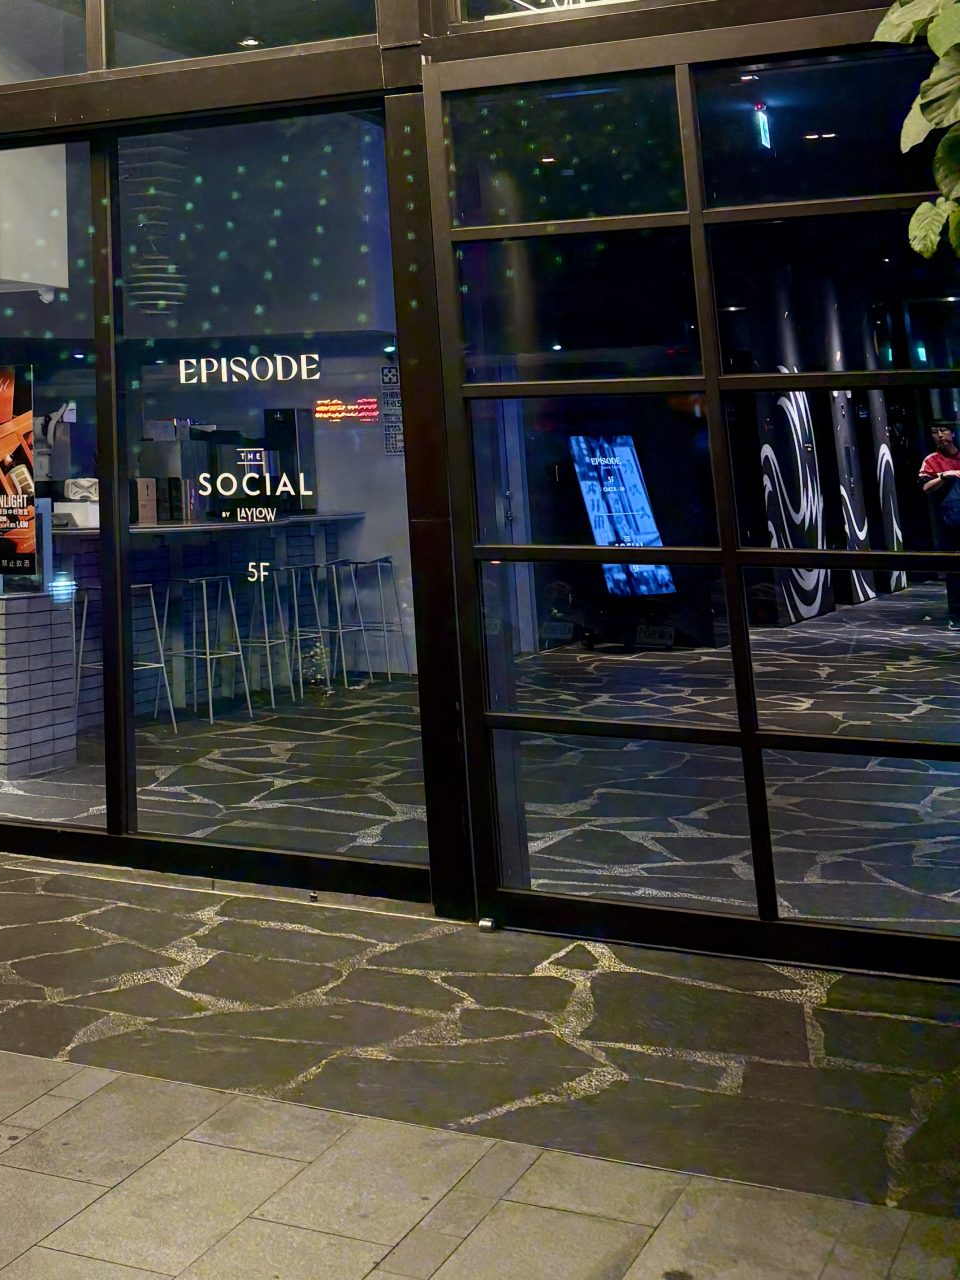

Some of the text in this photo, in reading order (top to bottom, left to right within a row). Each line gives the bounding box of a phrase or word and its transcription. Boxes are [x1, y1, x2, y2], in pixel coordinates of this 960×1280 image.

[178, 353, 320, 384] EPISODE
[239, 452, 261, 460] THE
[590, 456, 622, 466] EPISODE
[198, 472, 313, 496] SOCIAL
[236, 507, 277, 522] LAYLOW
[247, 562, 270, 582] 5F
